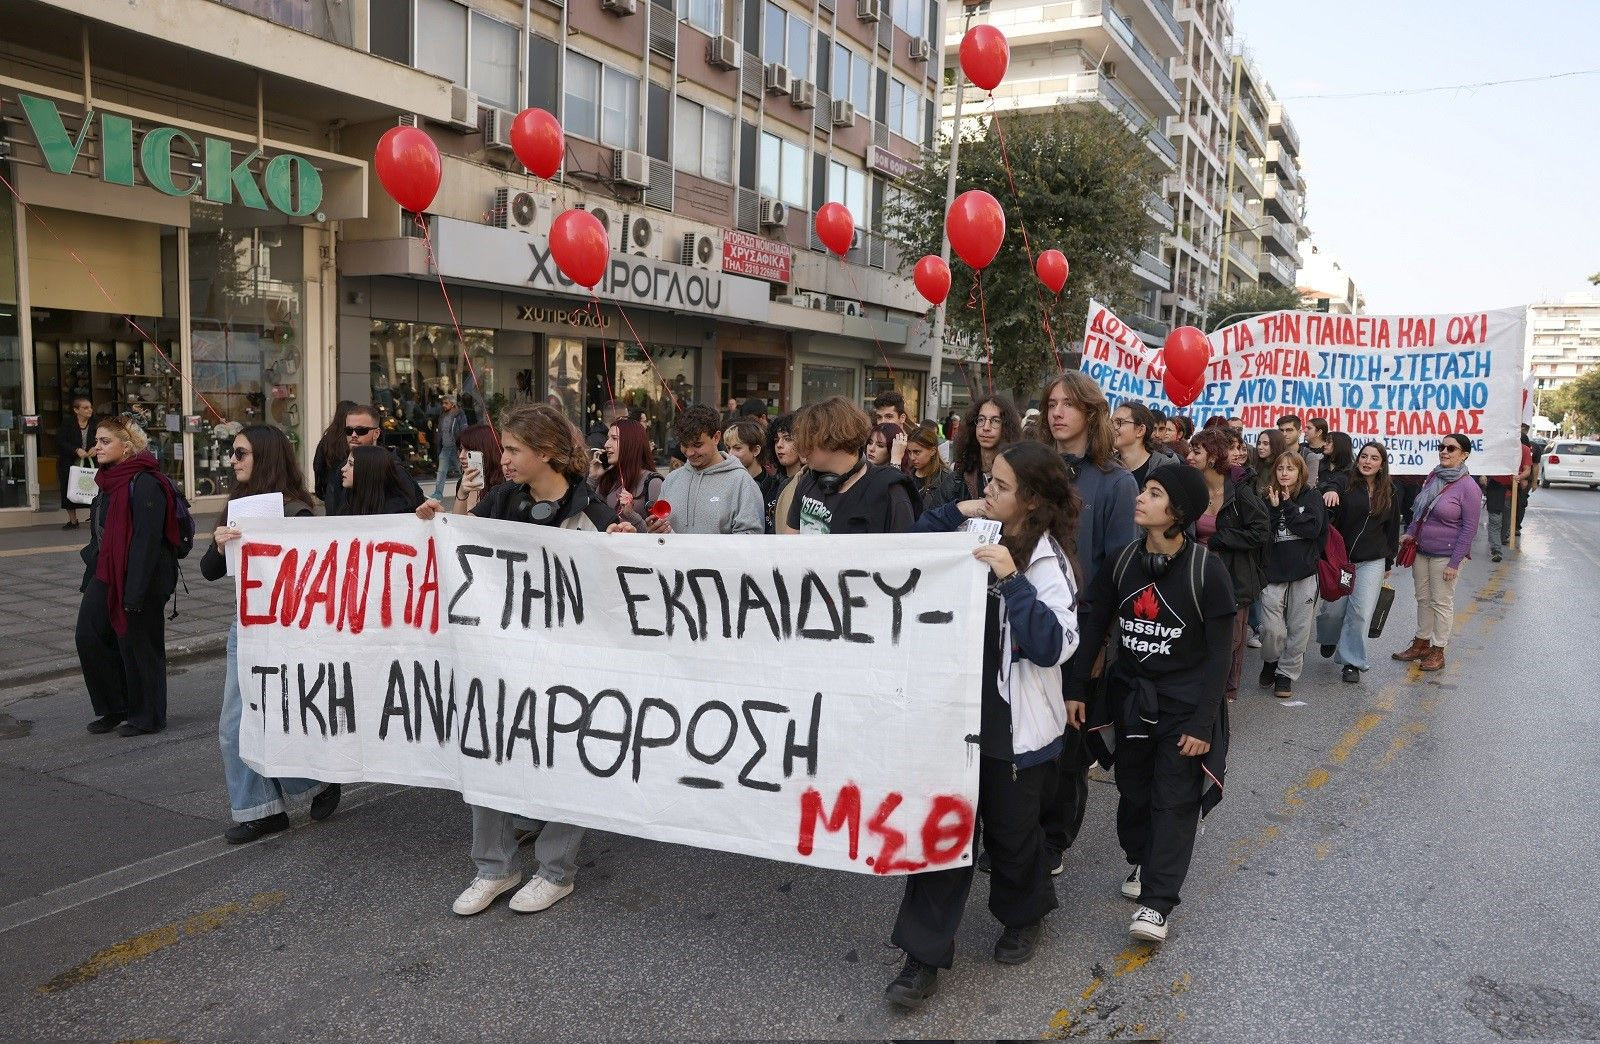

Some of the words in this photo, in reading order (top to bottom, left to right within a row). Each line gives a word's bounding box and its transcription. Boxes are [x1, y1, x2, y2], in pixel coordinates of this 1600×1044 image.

[18, 93, 323, 217] VICKO
[724, 231, 755, 248] ΑΓΟΡΑΖΩ
[724, 257, 743, 272] ΤΗΛ.
[744, 263, 760, 275] 2310
[730, 245, 786, 269] ΧΡΥΣΑΦΙΚΑ
[1222, 322, 1255, 355] ΓΙΑ
[1258, 312, 1301, 345] ΤΗΝ
[1306, 315, 1391, 349] ΠΑΙΔΕΙΑ
[1398, 317, 1436, 348] ΚΑΙ
[1446, 314, 1488, 345] ΟΧΙ
[1083, 335, 1110, 361] ΓΙΑ
[1233, 377, 1277, 405] ΑΥΤΟ
[1282, 379, 1332, 408] ΕΙΝΑΙ
[1339, 382, 1364, 409] ΤΟ
[1369, 382, 1489, 411] ΣΥΓΧΡΟΝΟ
[1345, 409, 1379, 434] ΤΗΣ
[1385, 410, 1485, 436] ΕΛΛΑΔΑΣ
[240, 537, 439, 634] ΕΝΑΝΤΙΑ
[448, 546, 585, 630] ΣΤΗΝ
[616, 566, 954, 645] ΕΚΠΑΙΔΕΥ-
